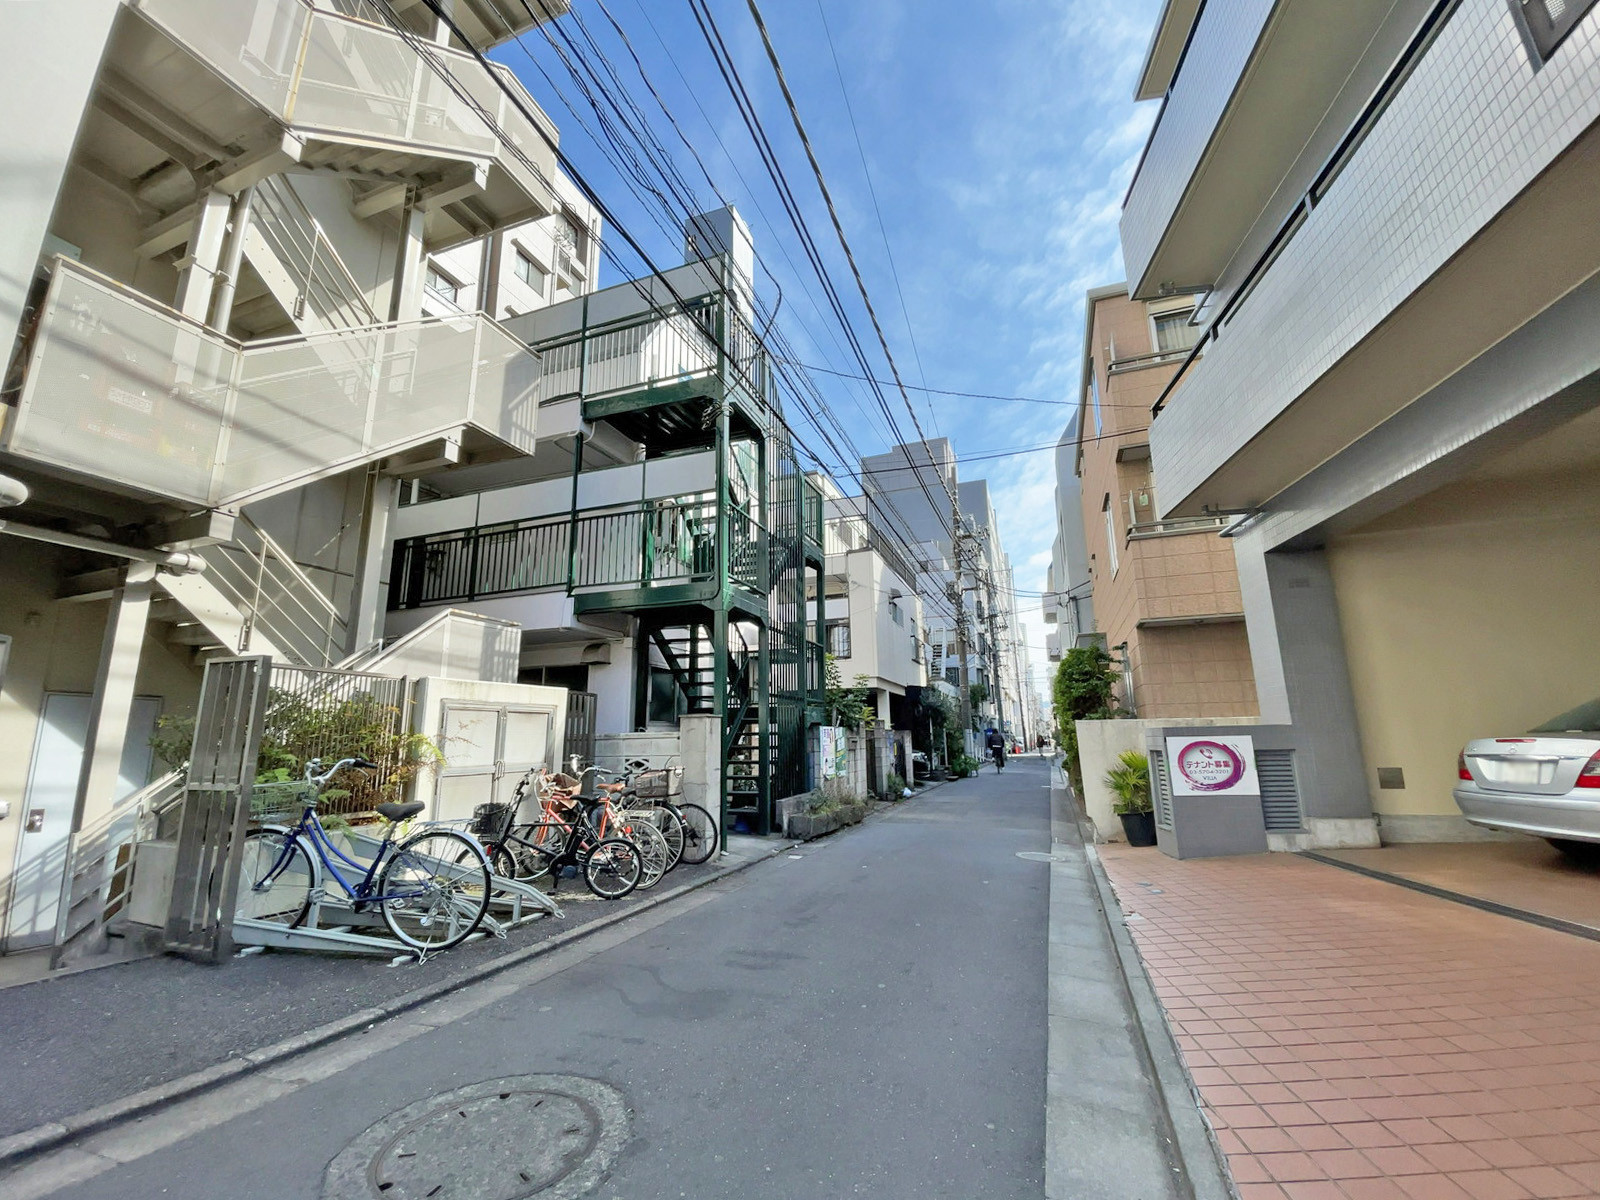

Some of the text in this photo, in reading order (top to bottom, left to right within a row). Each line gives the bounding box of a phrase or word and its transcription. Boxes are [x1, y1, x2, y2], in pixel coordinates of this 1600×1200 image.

[1186, 760, 1231, 769] テナント募集
